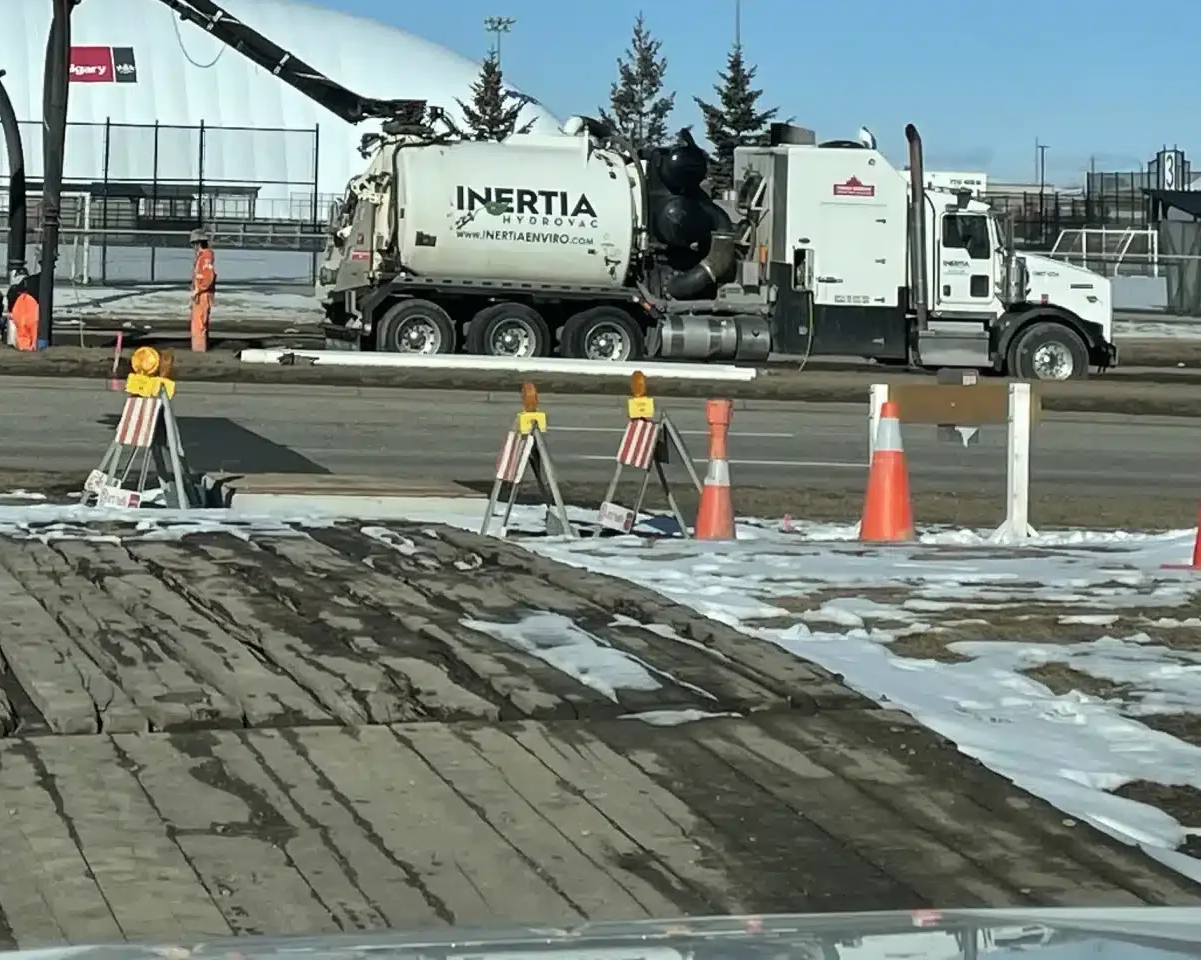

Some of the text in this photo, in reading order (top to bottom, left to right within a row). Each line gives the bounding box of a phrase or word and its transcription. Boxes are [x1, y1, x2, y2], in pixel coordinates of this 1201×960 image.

[70, 63, 106, 75] lgary
[1165, 154, 1174, 188] 3
[456, 185, 598, 217] INERTIA
[502, 215, 599, 228] HYDROVAC
